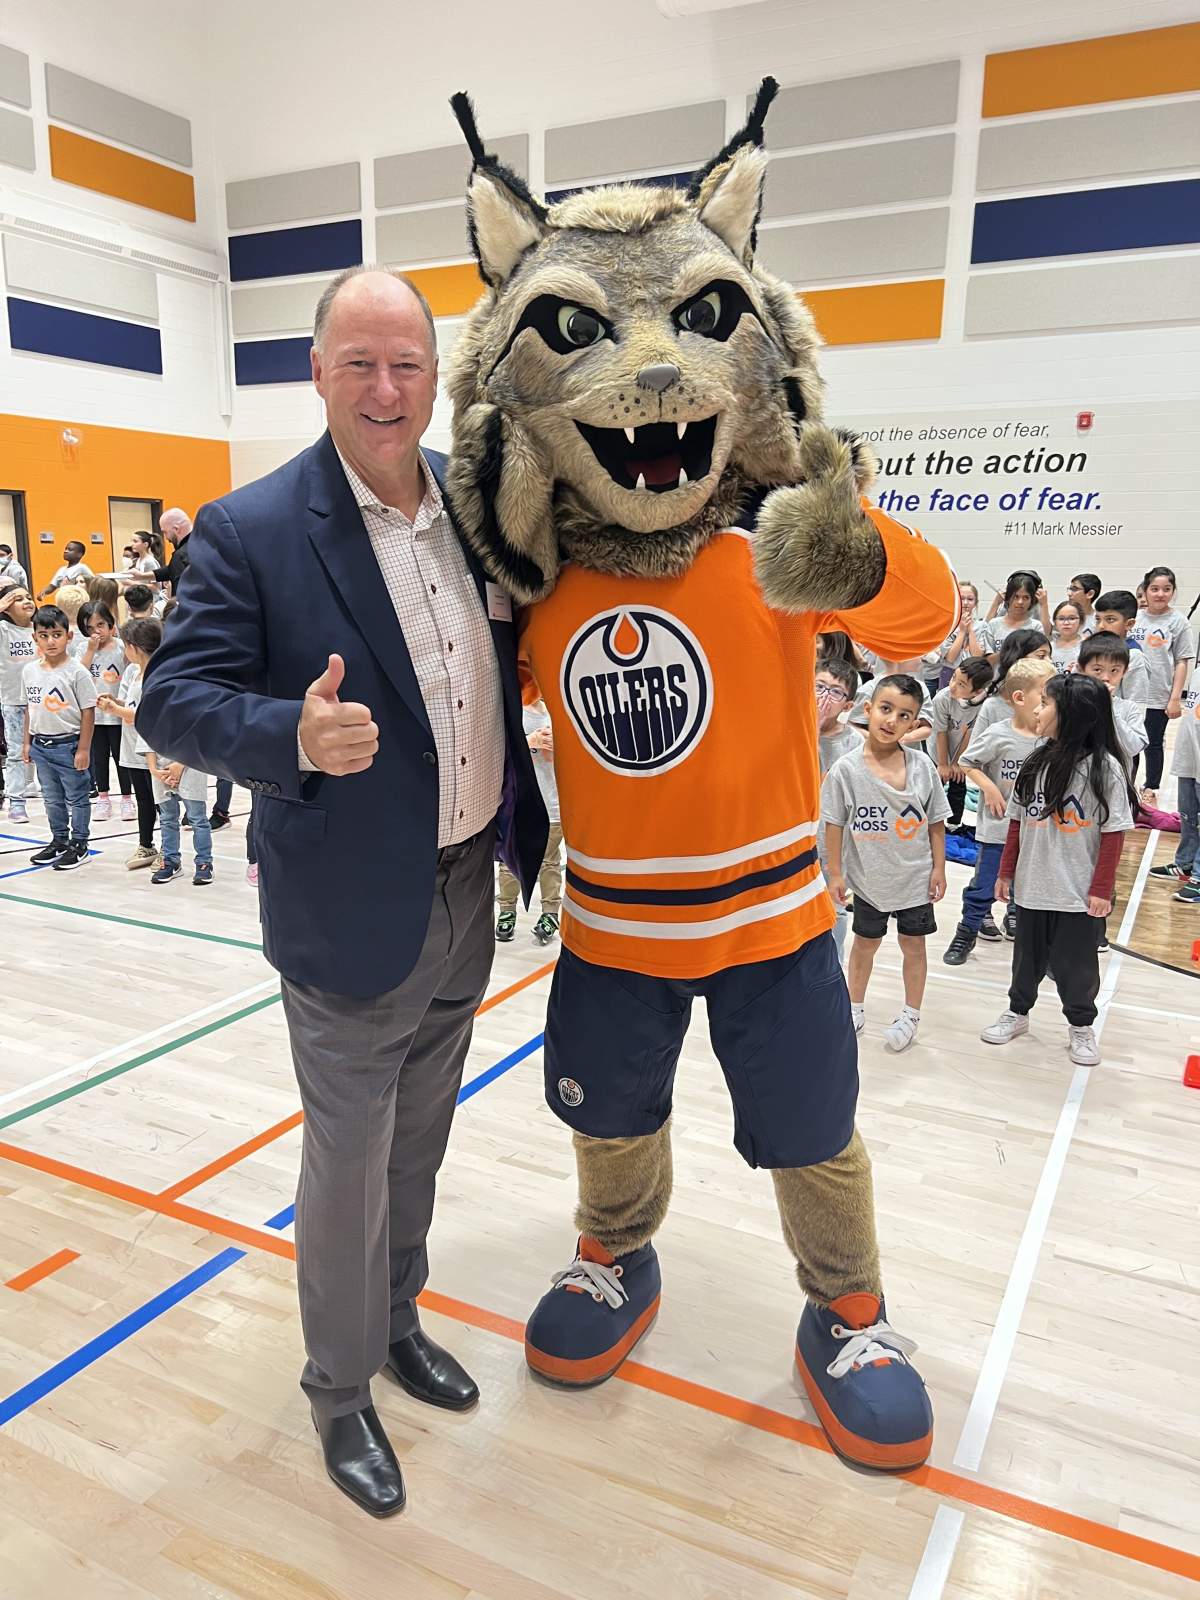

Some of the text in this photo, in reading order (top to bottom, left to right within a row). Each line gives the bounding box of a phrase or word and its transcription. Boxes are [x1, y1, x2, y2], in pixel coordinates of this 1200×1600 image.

[889, 427, 913, 441] the
[918, 426, 987, 441] absence
[993, 423, 1011, 438] of
[1014, 422, 1049, 438] fear,
[925, 449, 973, 475] the
[983, 447, 1087, 474] action
[879, 487, 1101, 511] the face of fear.
[1004, 521, 1123, 535] #11 Mark Messier
[10, 641, 33, 649] JOEY
[578, 663, 689, 762] OILERS
[1001, 771, 1018, 780] MO
[855, 806, 888, 818] OEY
